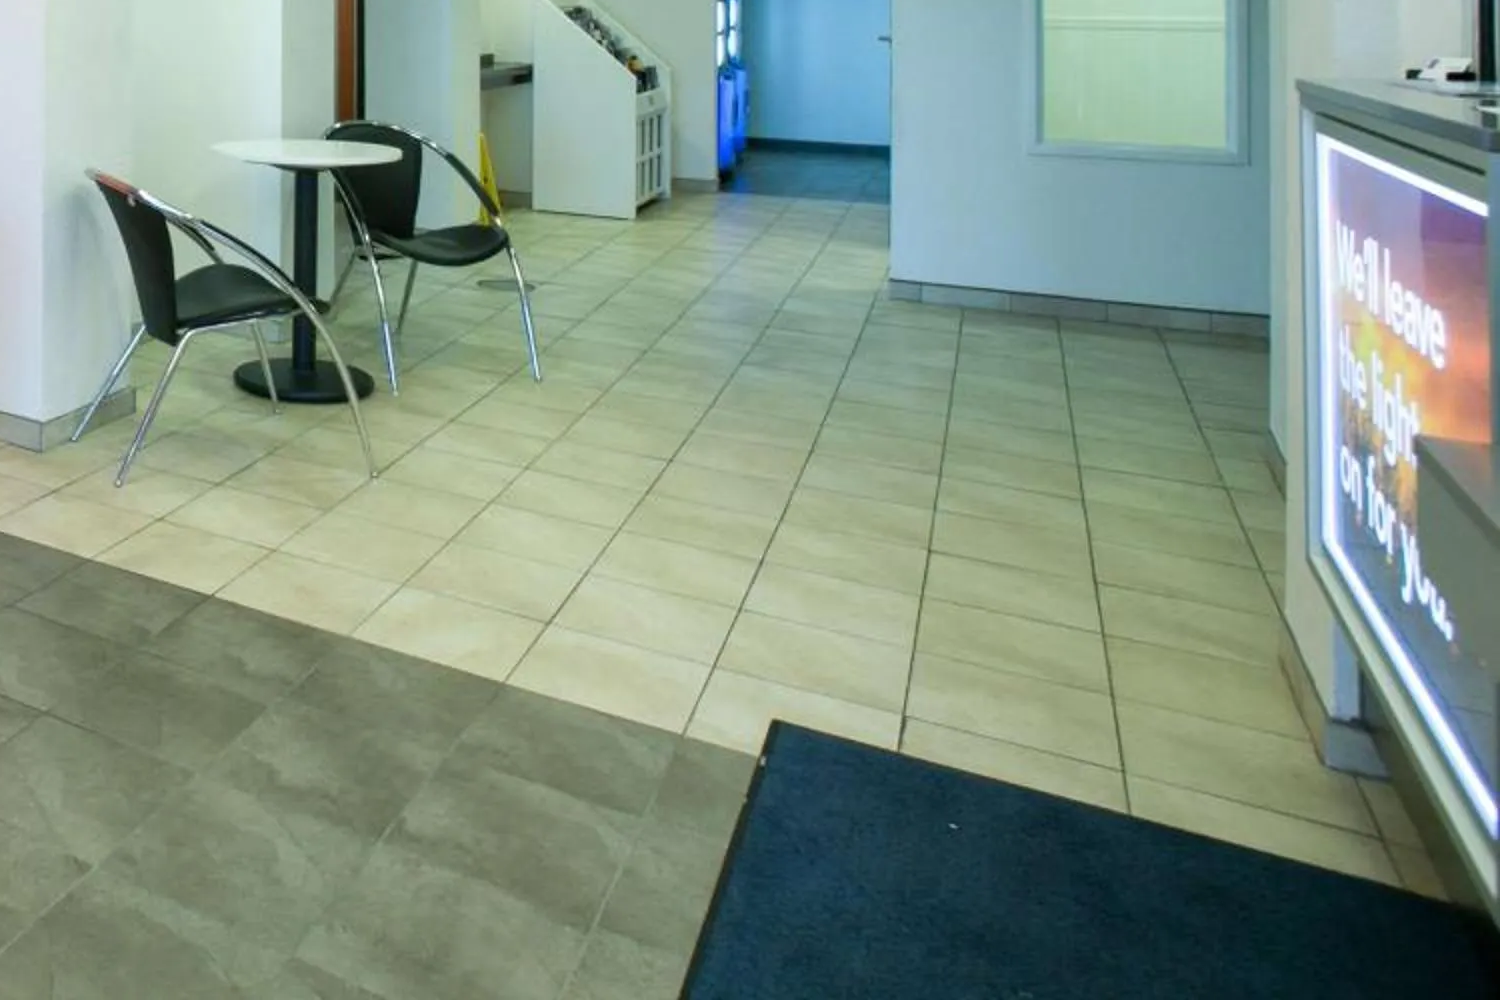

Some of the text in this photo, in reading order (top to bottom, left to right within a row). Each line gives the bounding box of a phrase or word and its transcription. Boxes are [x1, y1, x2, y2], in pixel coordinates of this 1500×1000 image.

[1335, 218, 1445, 370] We'll leave
[1339, 323, 1420, 471] the light
[1339, 444, 1363, 512] on
[1367, 454, 1397, 557] for
